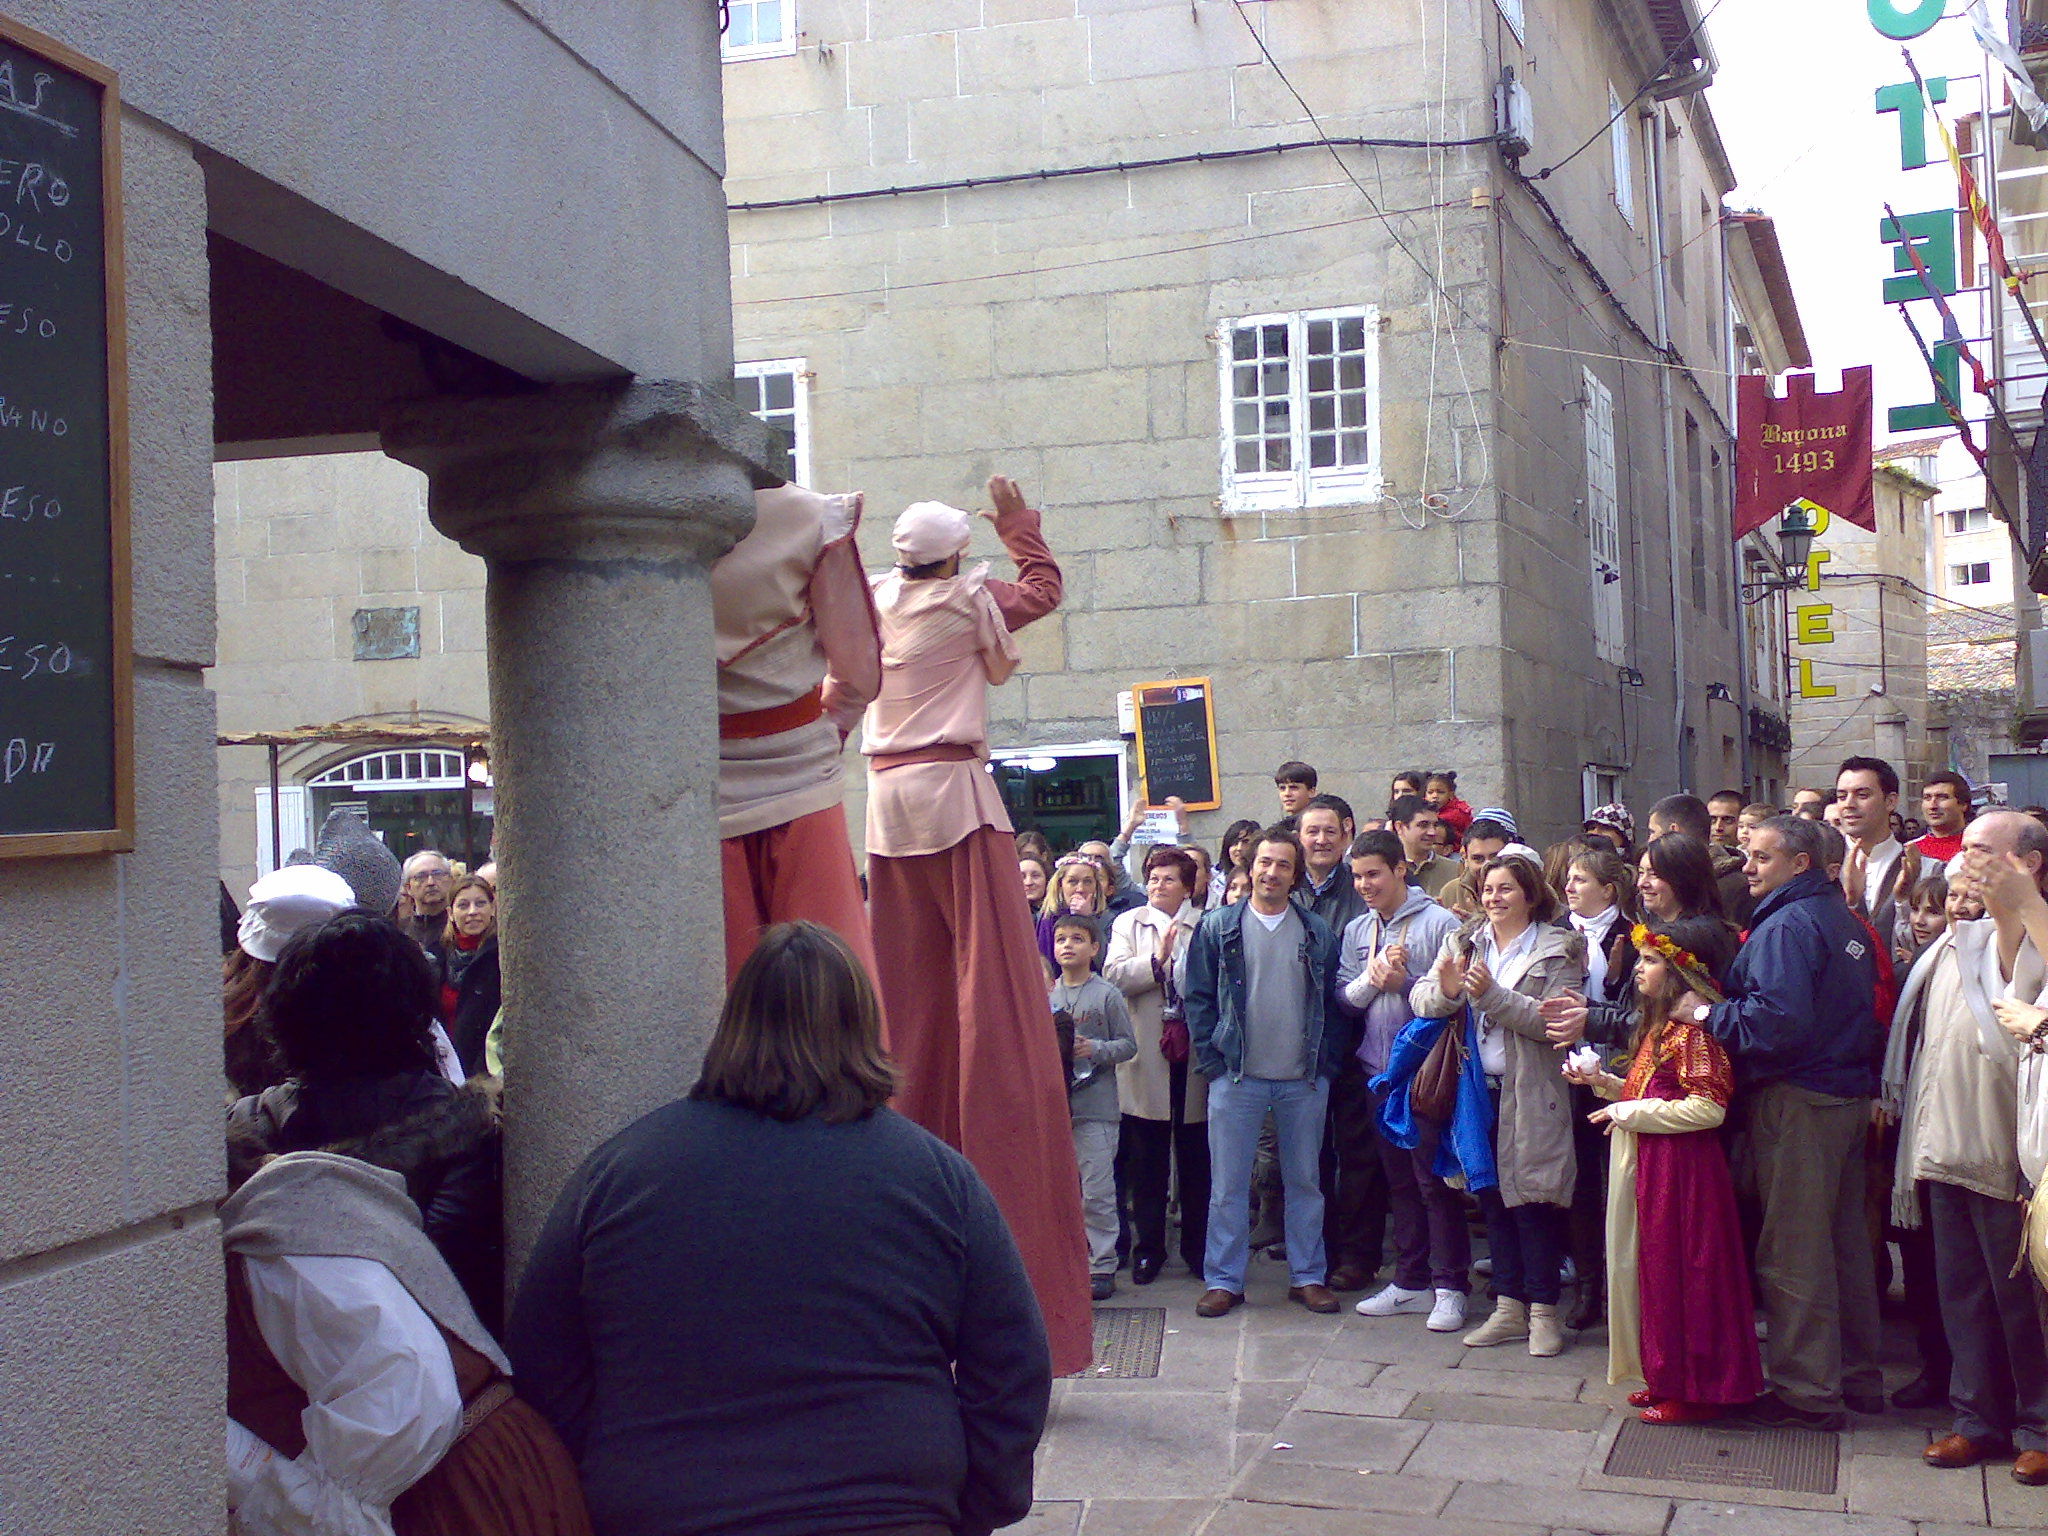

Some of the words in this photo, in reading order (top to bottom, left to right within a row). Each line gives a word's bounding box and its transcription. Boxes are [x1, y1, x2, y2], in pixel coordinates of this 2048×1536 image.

[1760, 423, 1847, 448] Bayona
[1774, 450, 1835, 474] 1493
[0, 486, 61, 521] ESO
